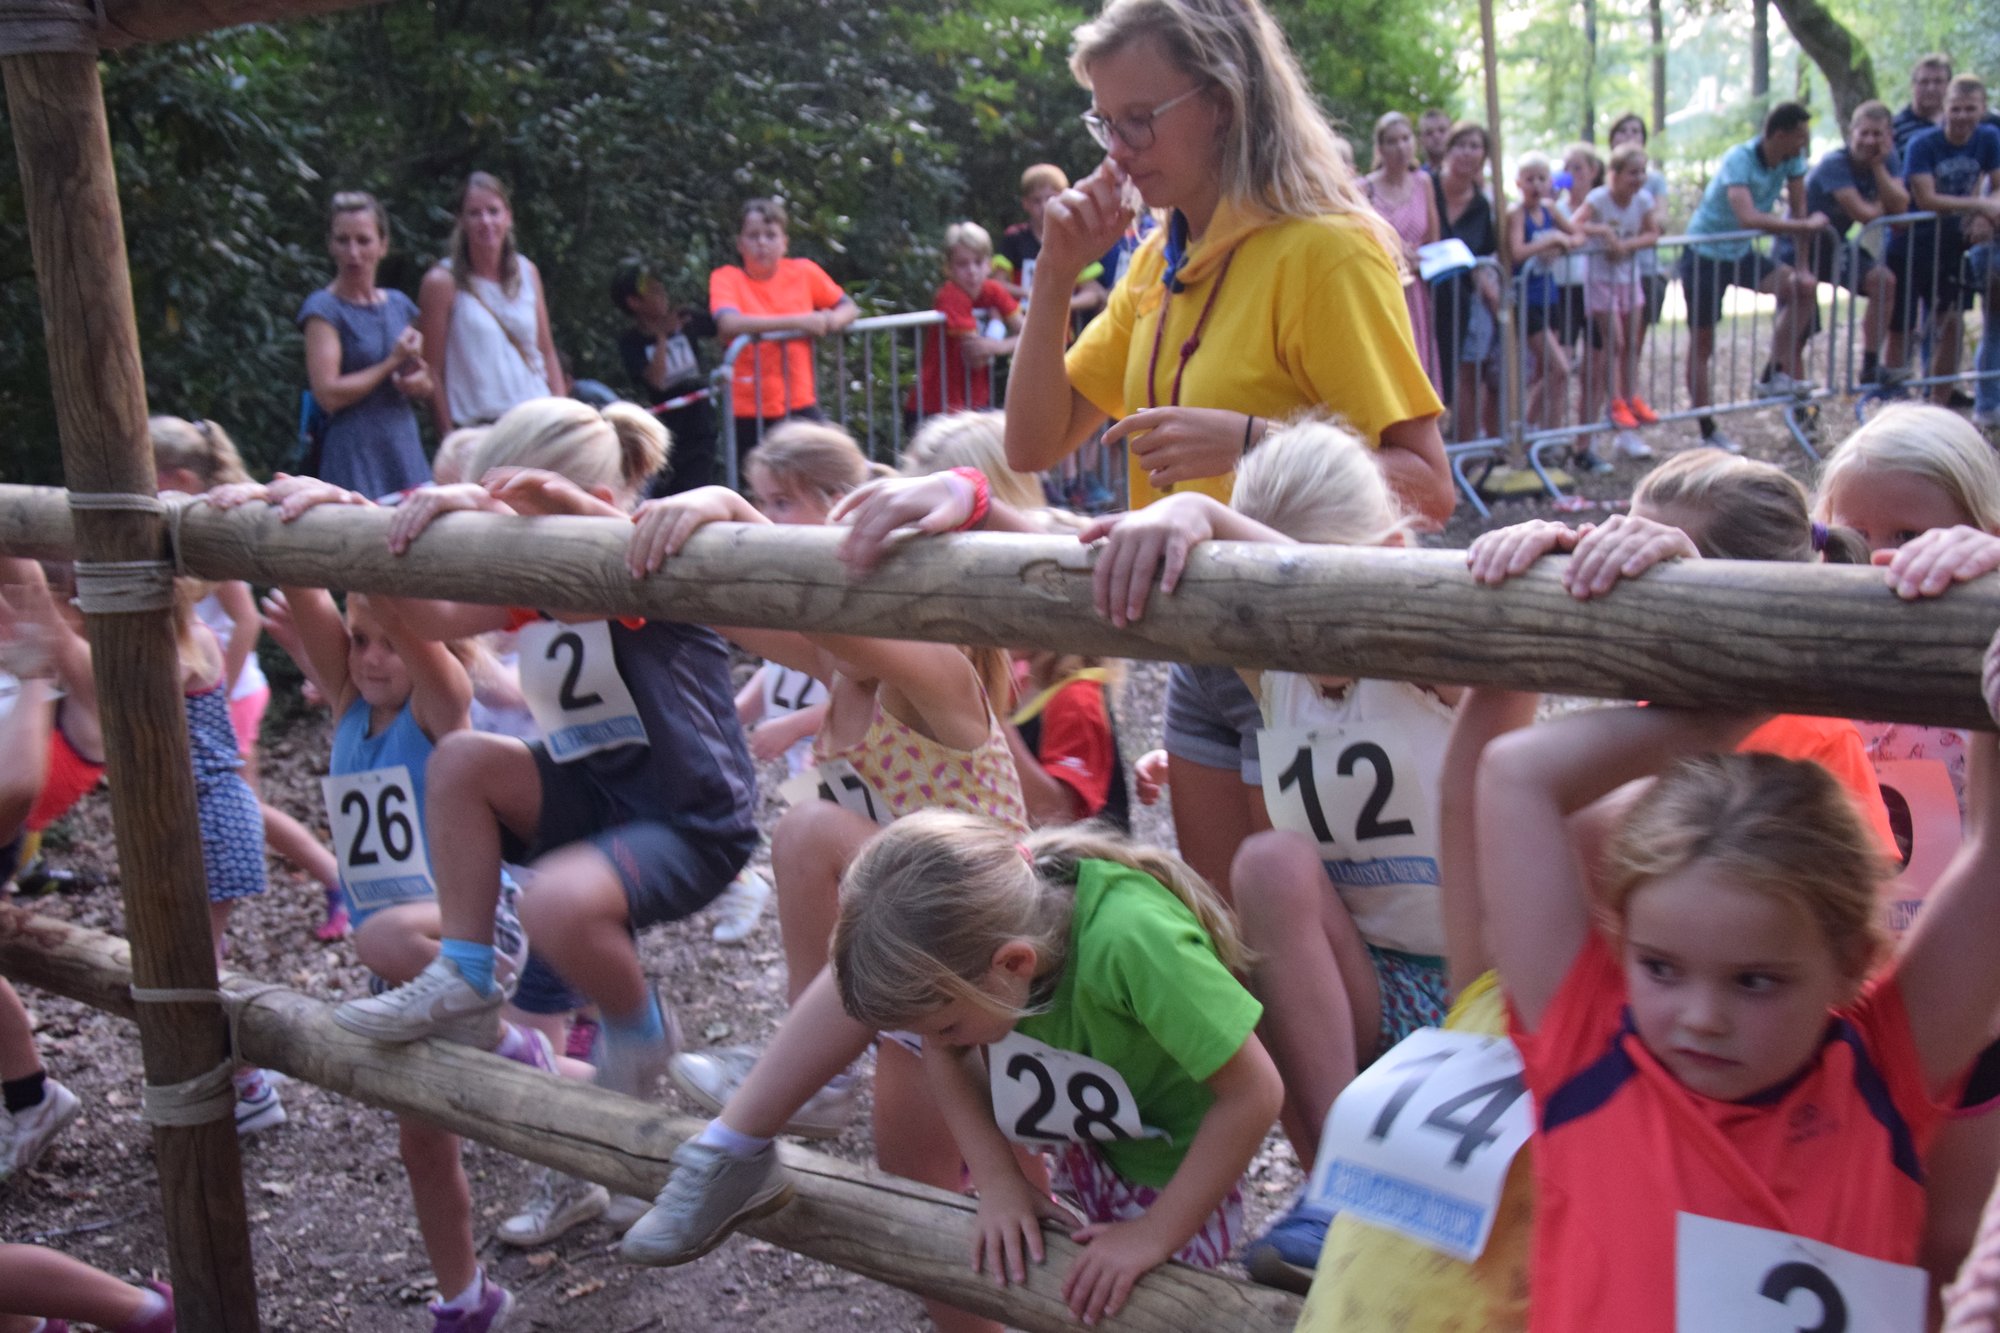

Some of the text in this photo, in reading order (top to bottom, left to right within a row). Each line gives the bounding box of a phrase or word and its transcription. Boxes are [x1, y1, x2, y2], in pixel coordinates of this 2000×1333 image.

[546, 631, 604, 711] 2
[341, 784, 414, 866] 26
[1278, 741, 1415, 844] 12
[1006, 1053, 1132, 1141] 28
[1369, 1048, 1527, 1168] 14
